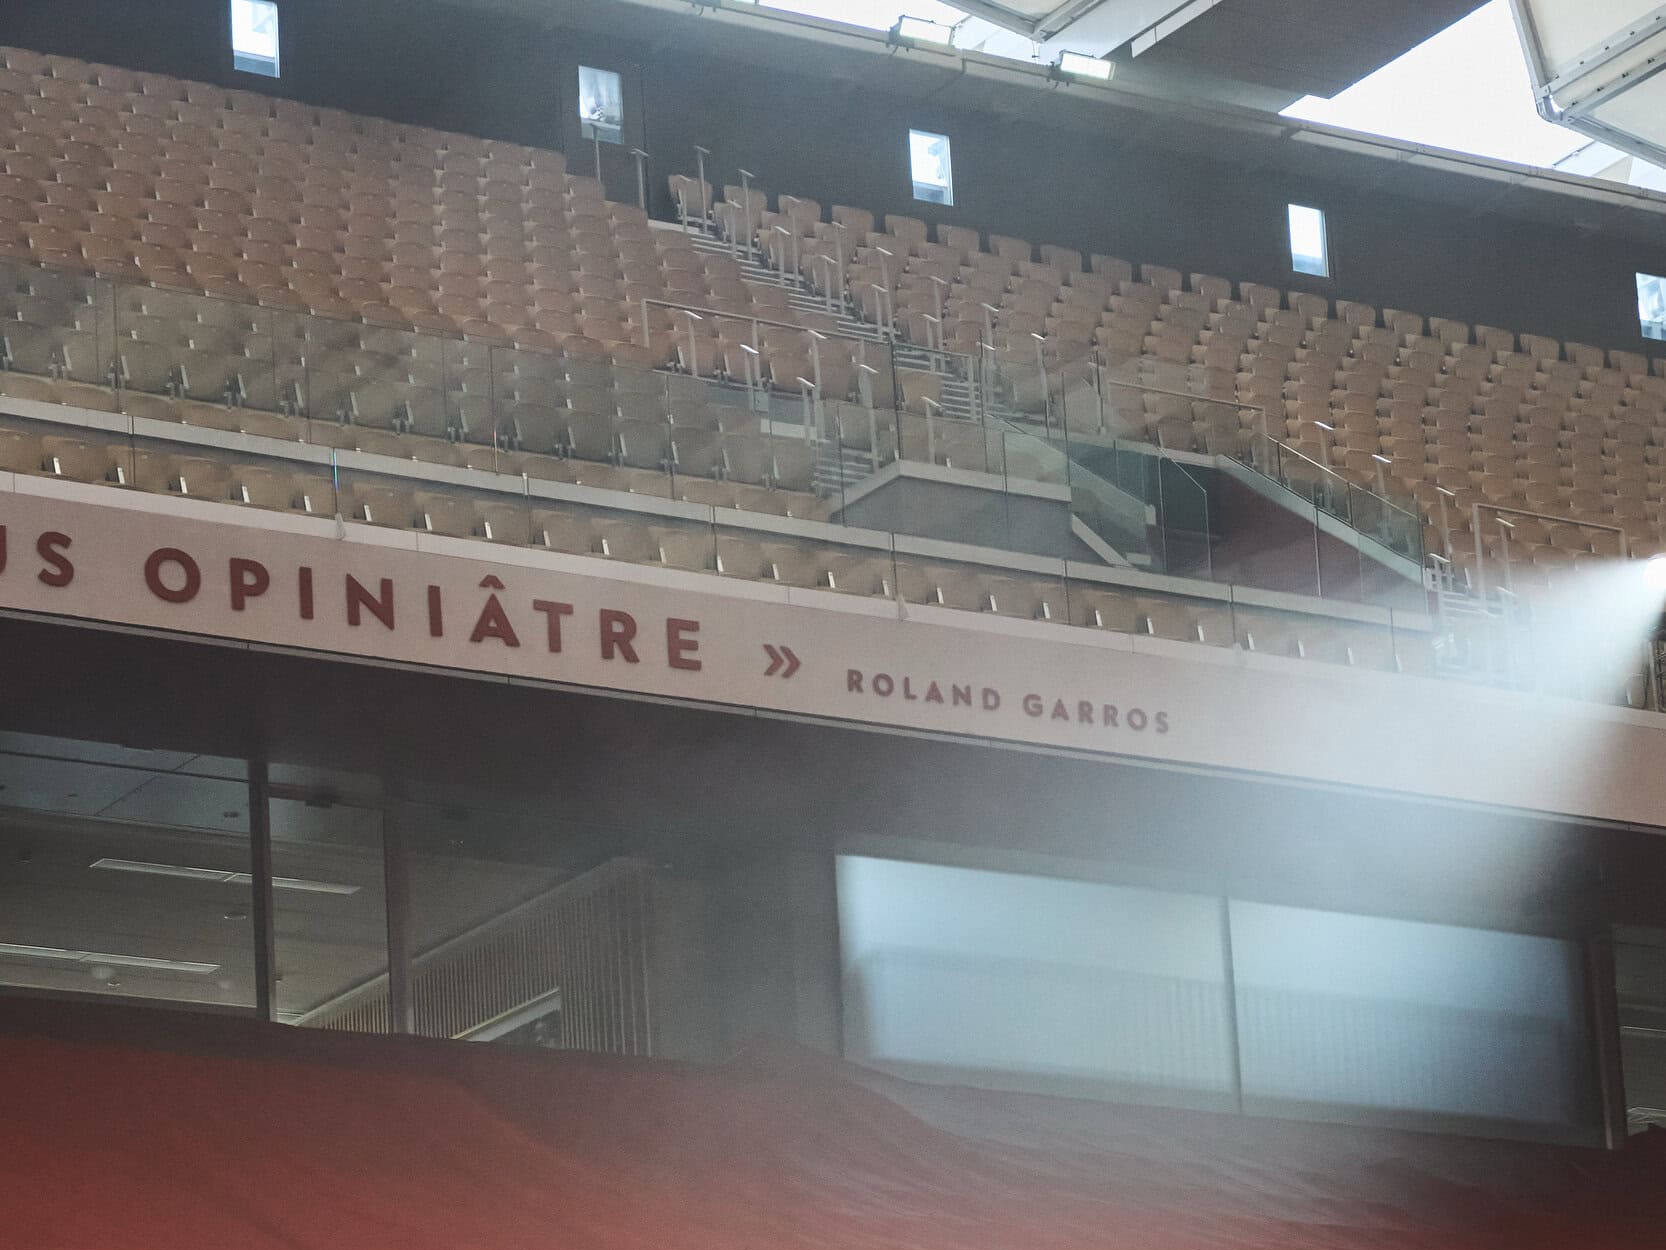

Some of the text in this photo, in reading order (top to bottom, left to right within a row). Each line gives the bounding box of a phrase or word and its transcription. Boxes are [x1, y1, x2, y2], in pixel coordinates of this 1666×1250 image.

[0, 524, 75, 588] S
[144, 547, 702, 672] OPINIÂTRE
[847, 668, 1170, 735] ROLAND GARROS
